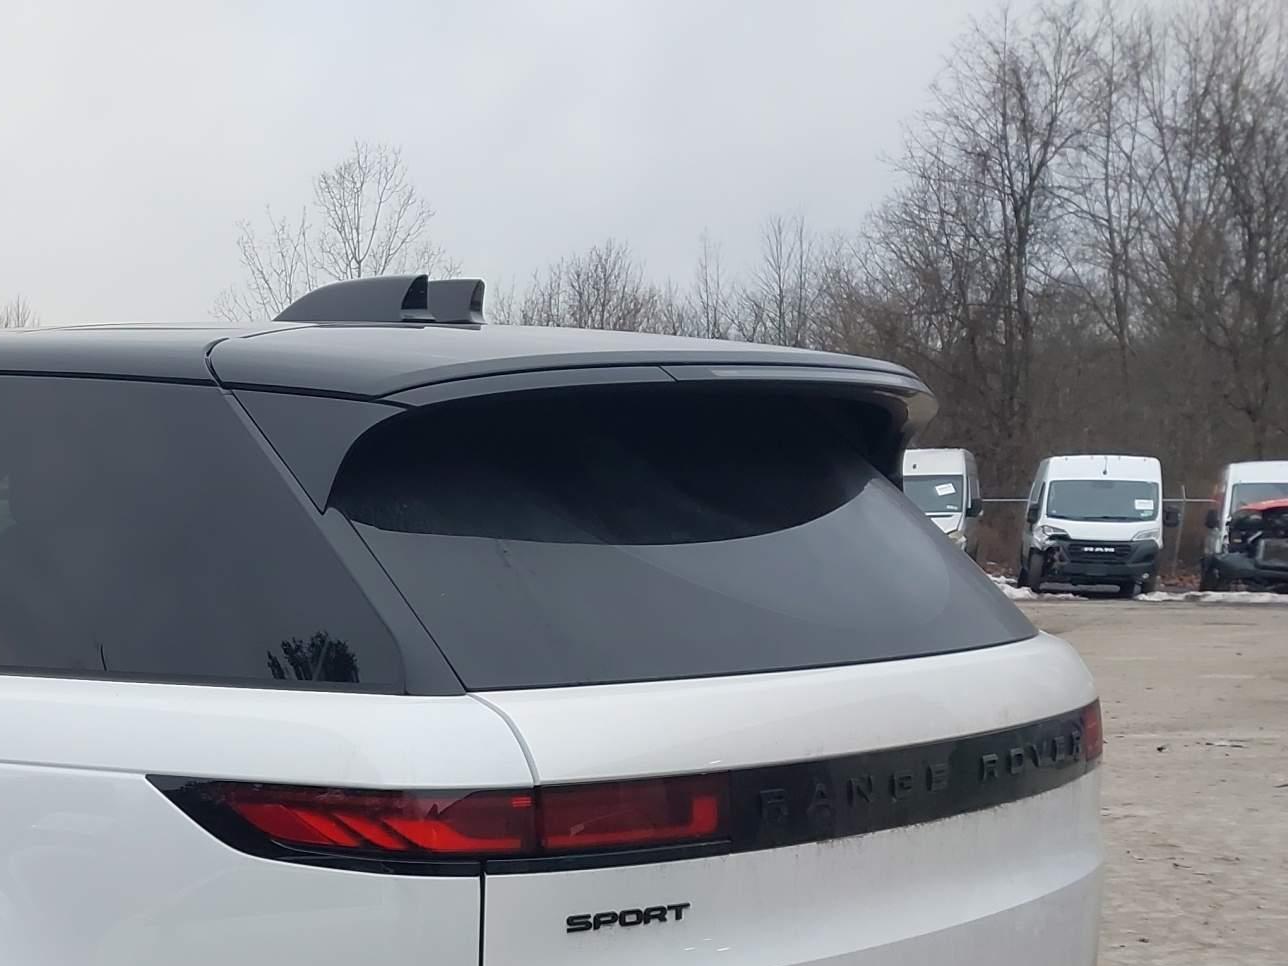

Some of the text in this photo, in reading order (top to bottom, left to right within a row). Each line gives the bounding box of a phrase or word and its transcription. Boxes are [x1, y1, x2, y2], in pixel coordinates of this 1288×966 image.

[759, 730, 1083, 824] RANGE ROVER
[566, 902, 691, 934] SPORT
